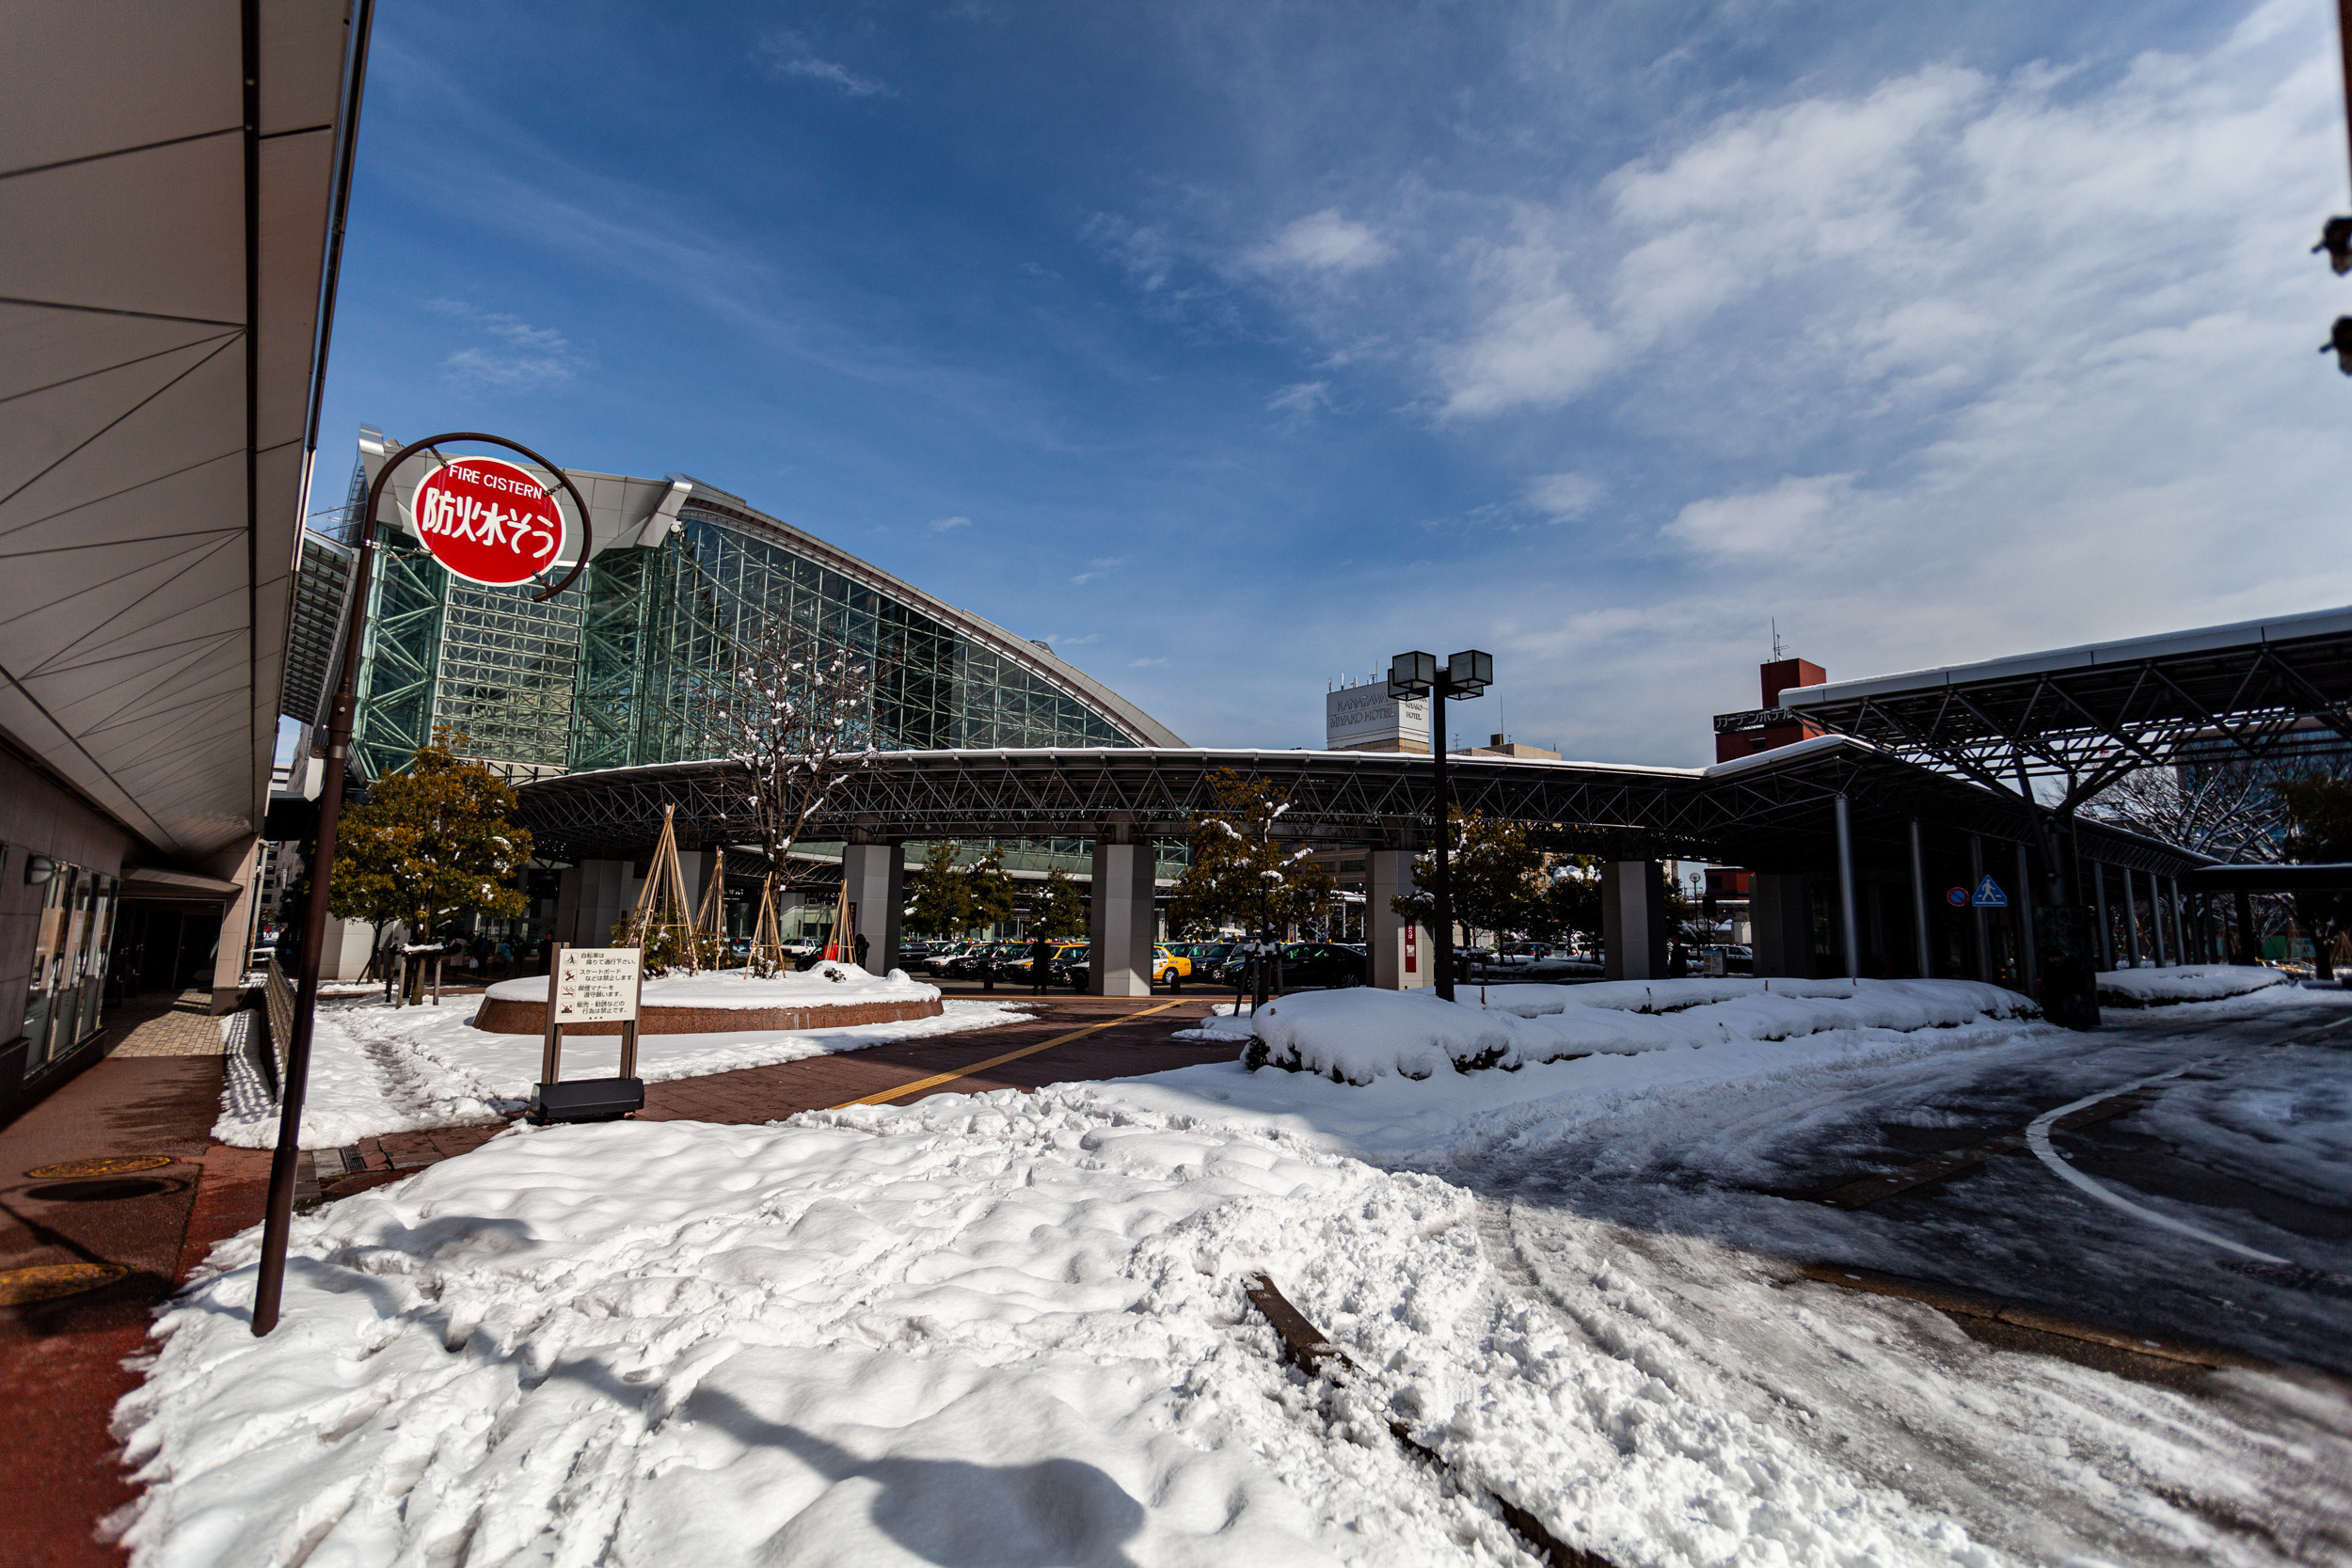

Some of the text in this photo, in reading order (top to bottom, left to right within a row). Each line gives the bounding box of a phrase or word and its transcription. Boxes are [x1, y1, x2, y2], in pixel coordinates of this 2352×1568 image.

[449, 465, 543, 500] FIRE CISTERN
[421, 486, 555, 559] 防火水そう
[1337, 692, 1389, 712] KANAZAWA
[1329, 706, 1396, 729] MIYAKO HOTEL
[1406, 711, 1422, 721] HOTEL
